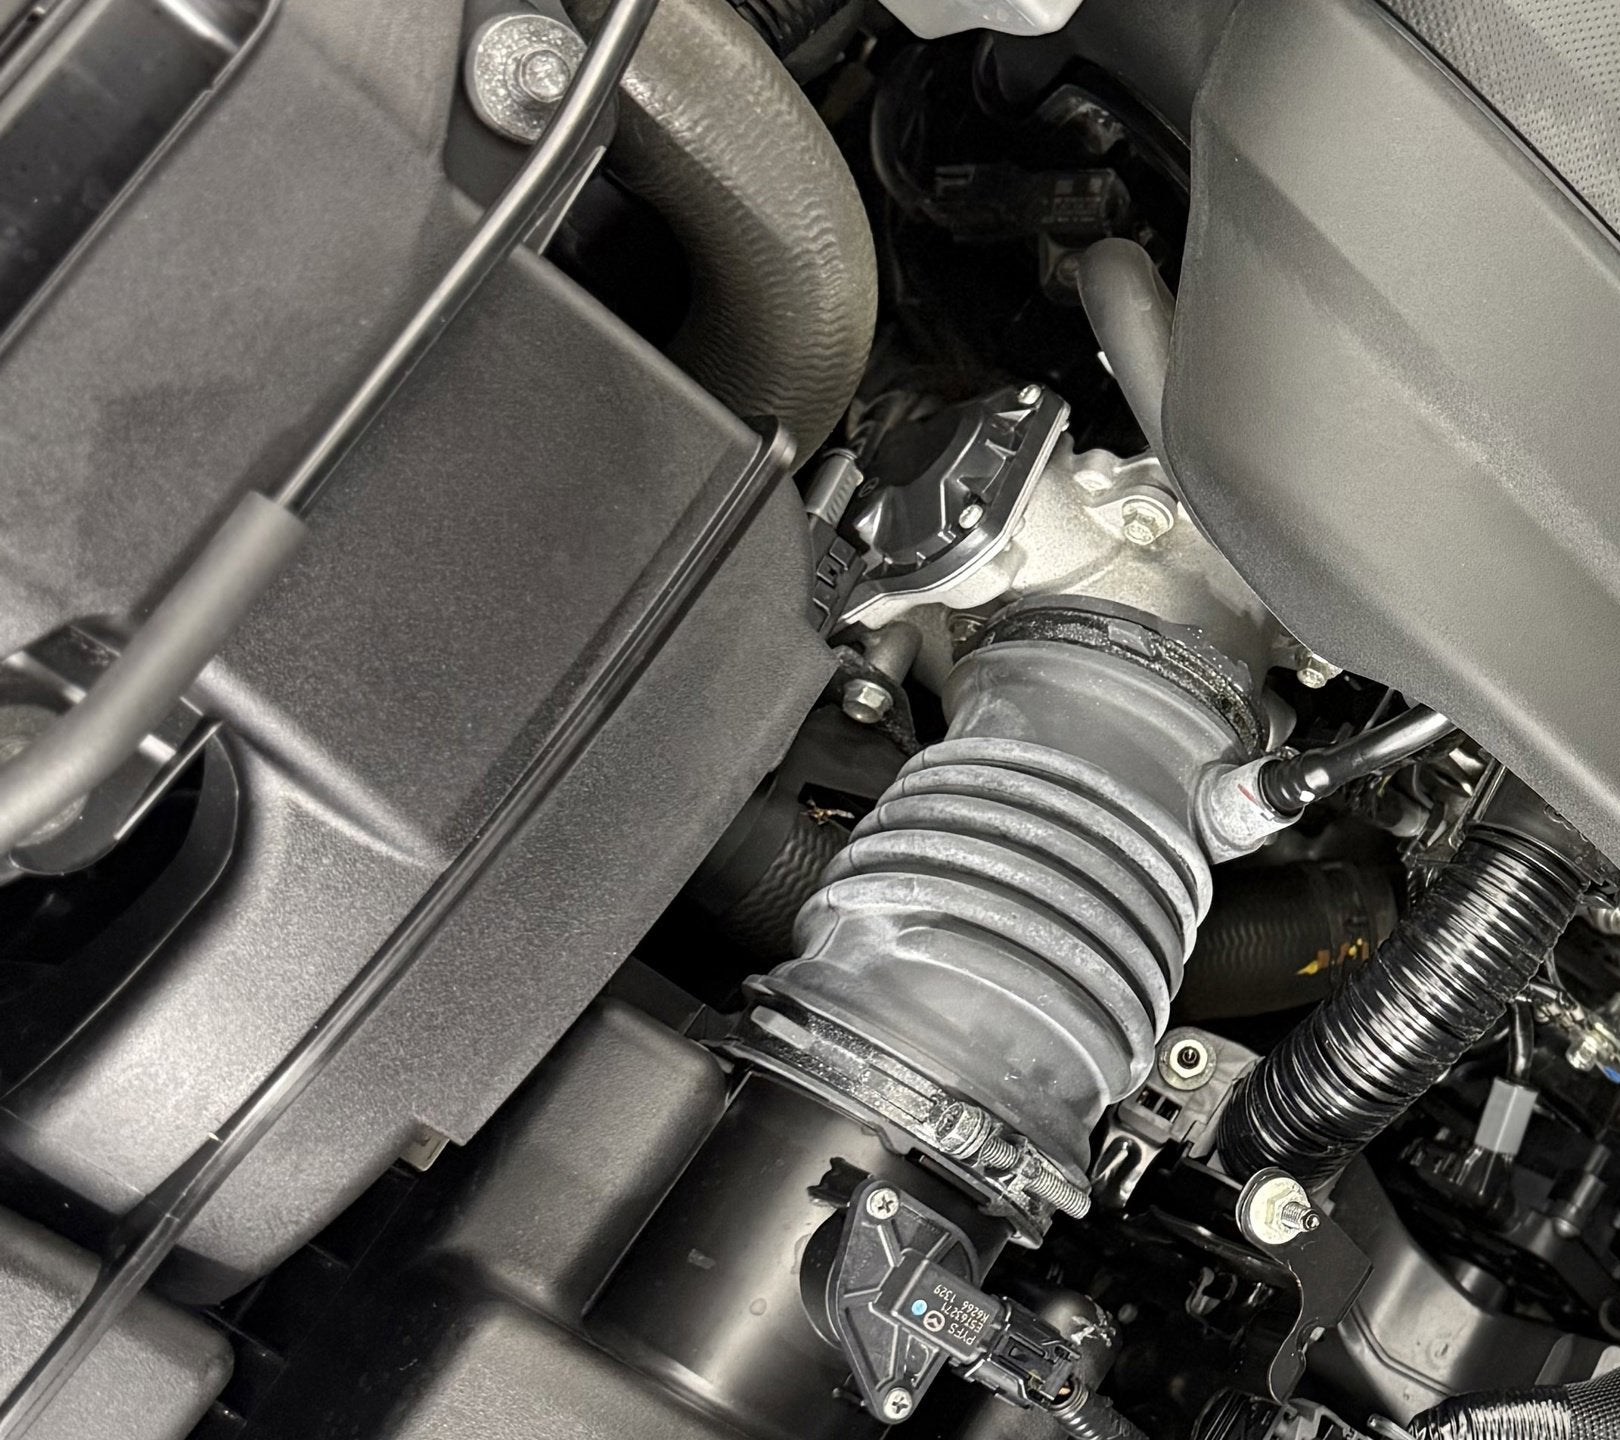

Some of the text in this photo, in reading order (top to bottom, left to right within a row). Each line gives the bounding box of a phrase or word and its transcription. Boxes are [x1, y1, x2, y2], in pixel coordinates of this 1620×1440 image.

[932, 1283, 989, 1323] K6266 1329
[947, 1322, 976, 1345] PYFS
